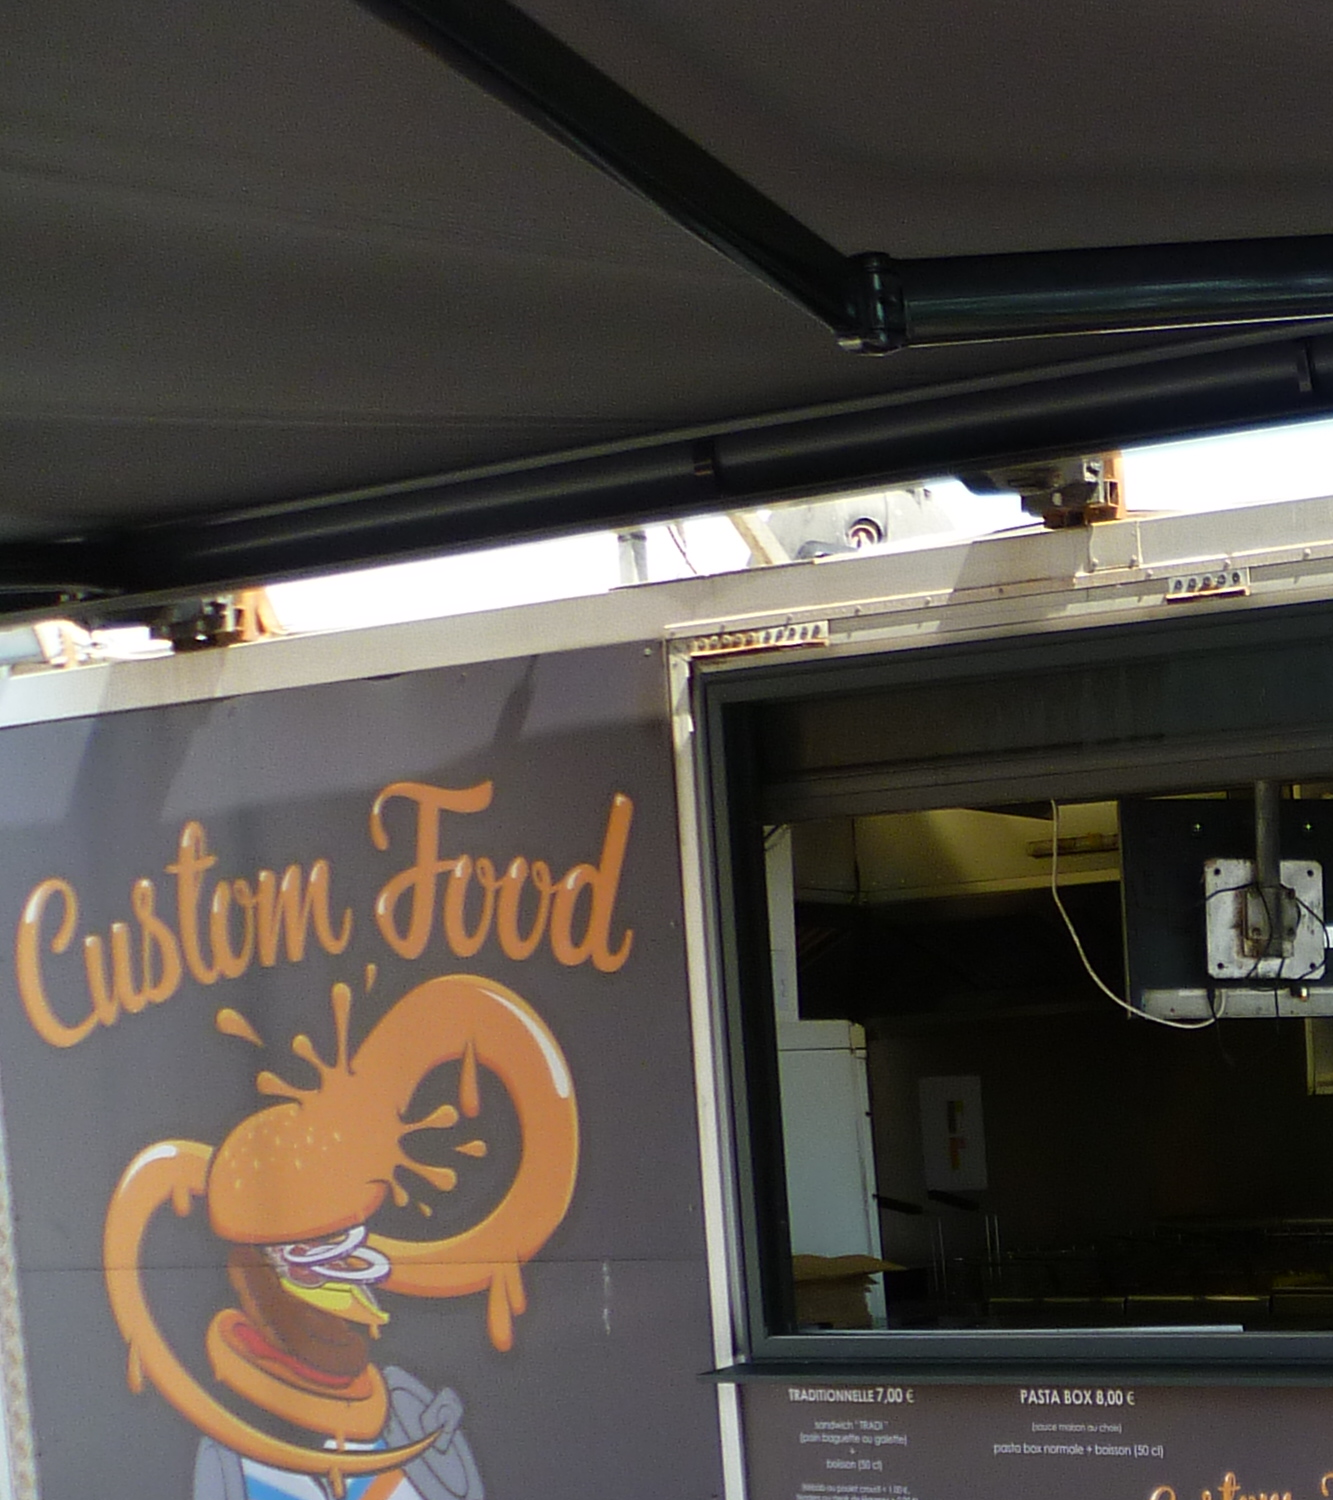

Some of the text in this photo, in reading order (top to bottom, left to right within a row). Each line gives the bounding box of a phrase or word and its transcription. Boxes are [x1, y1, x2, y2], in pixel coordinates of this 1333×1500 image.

[14, 780, 635, 1049] Custom Food
[1020, 1388, 1136, 1408] PASTA BOX 8,00 €
